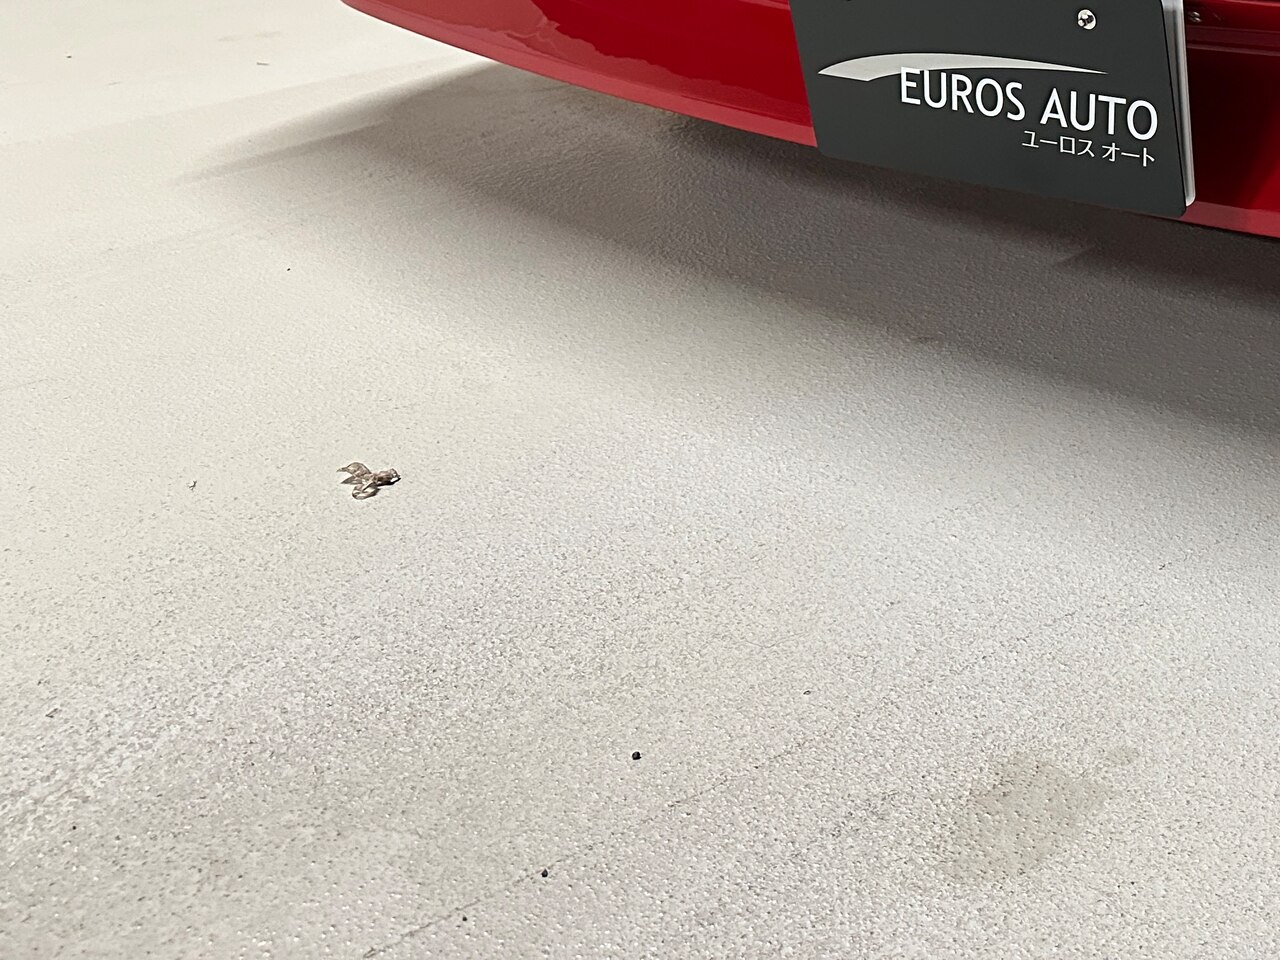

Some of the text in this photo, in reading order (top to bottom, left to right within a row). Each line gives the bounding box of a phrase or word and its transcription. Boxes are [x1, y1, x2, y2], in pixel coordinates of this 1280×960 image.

[901, 66, 1158, 140] EUROS AUTO
[1021, 130, 1155, 167] ユーロス オート
